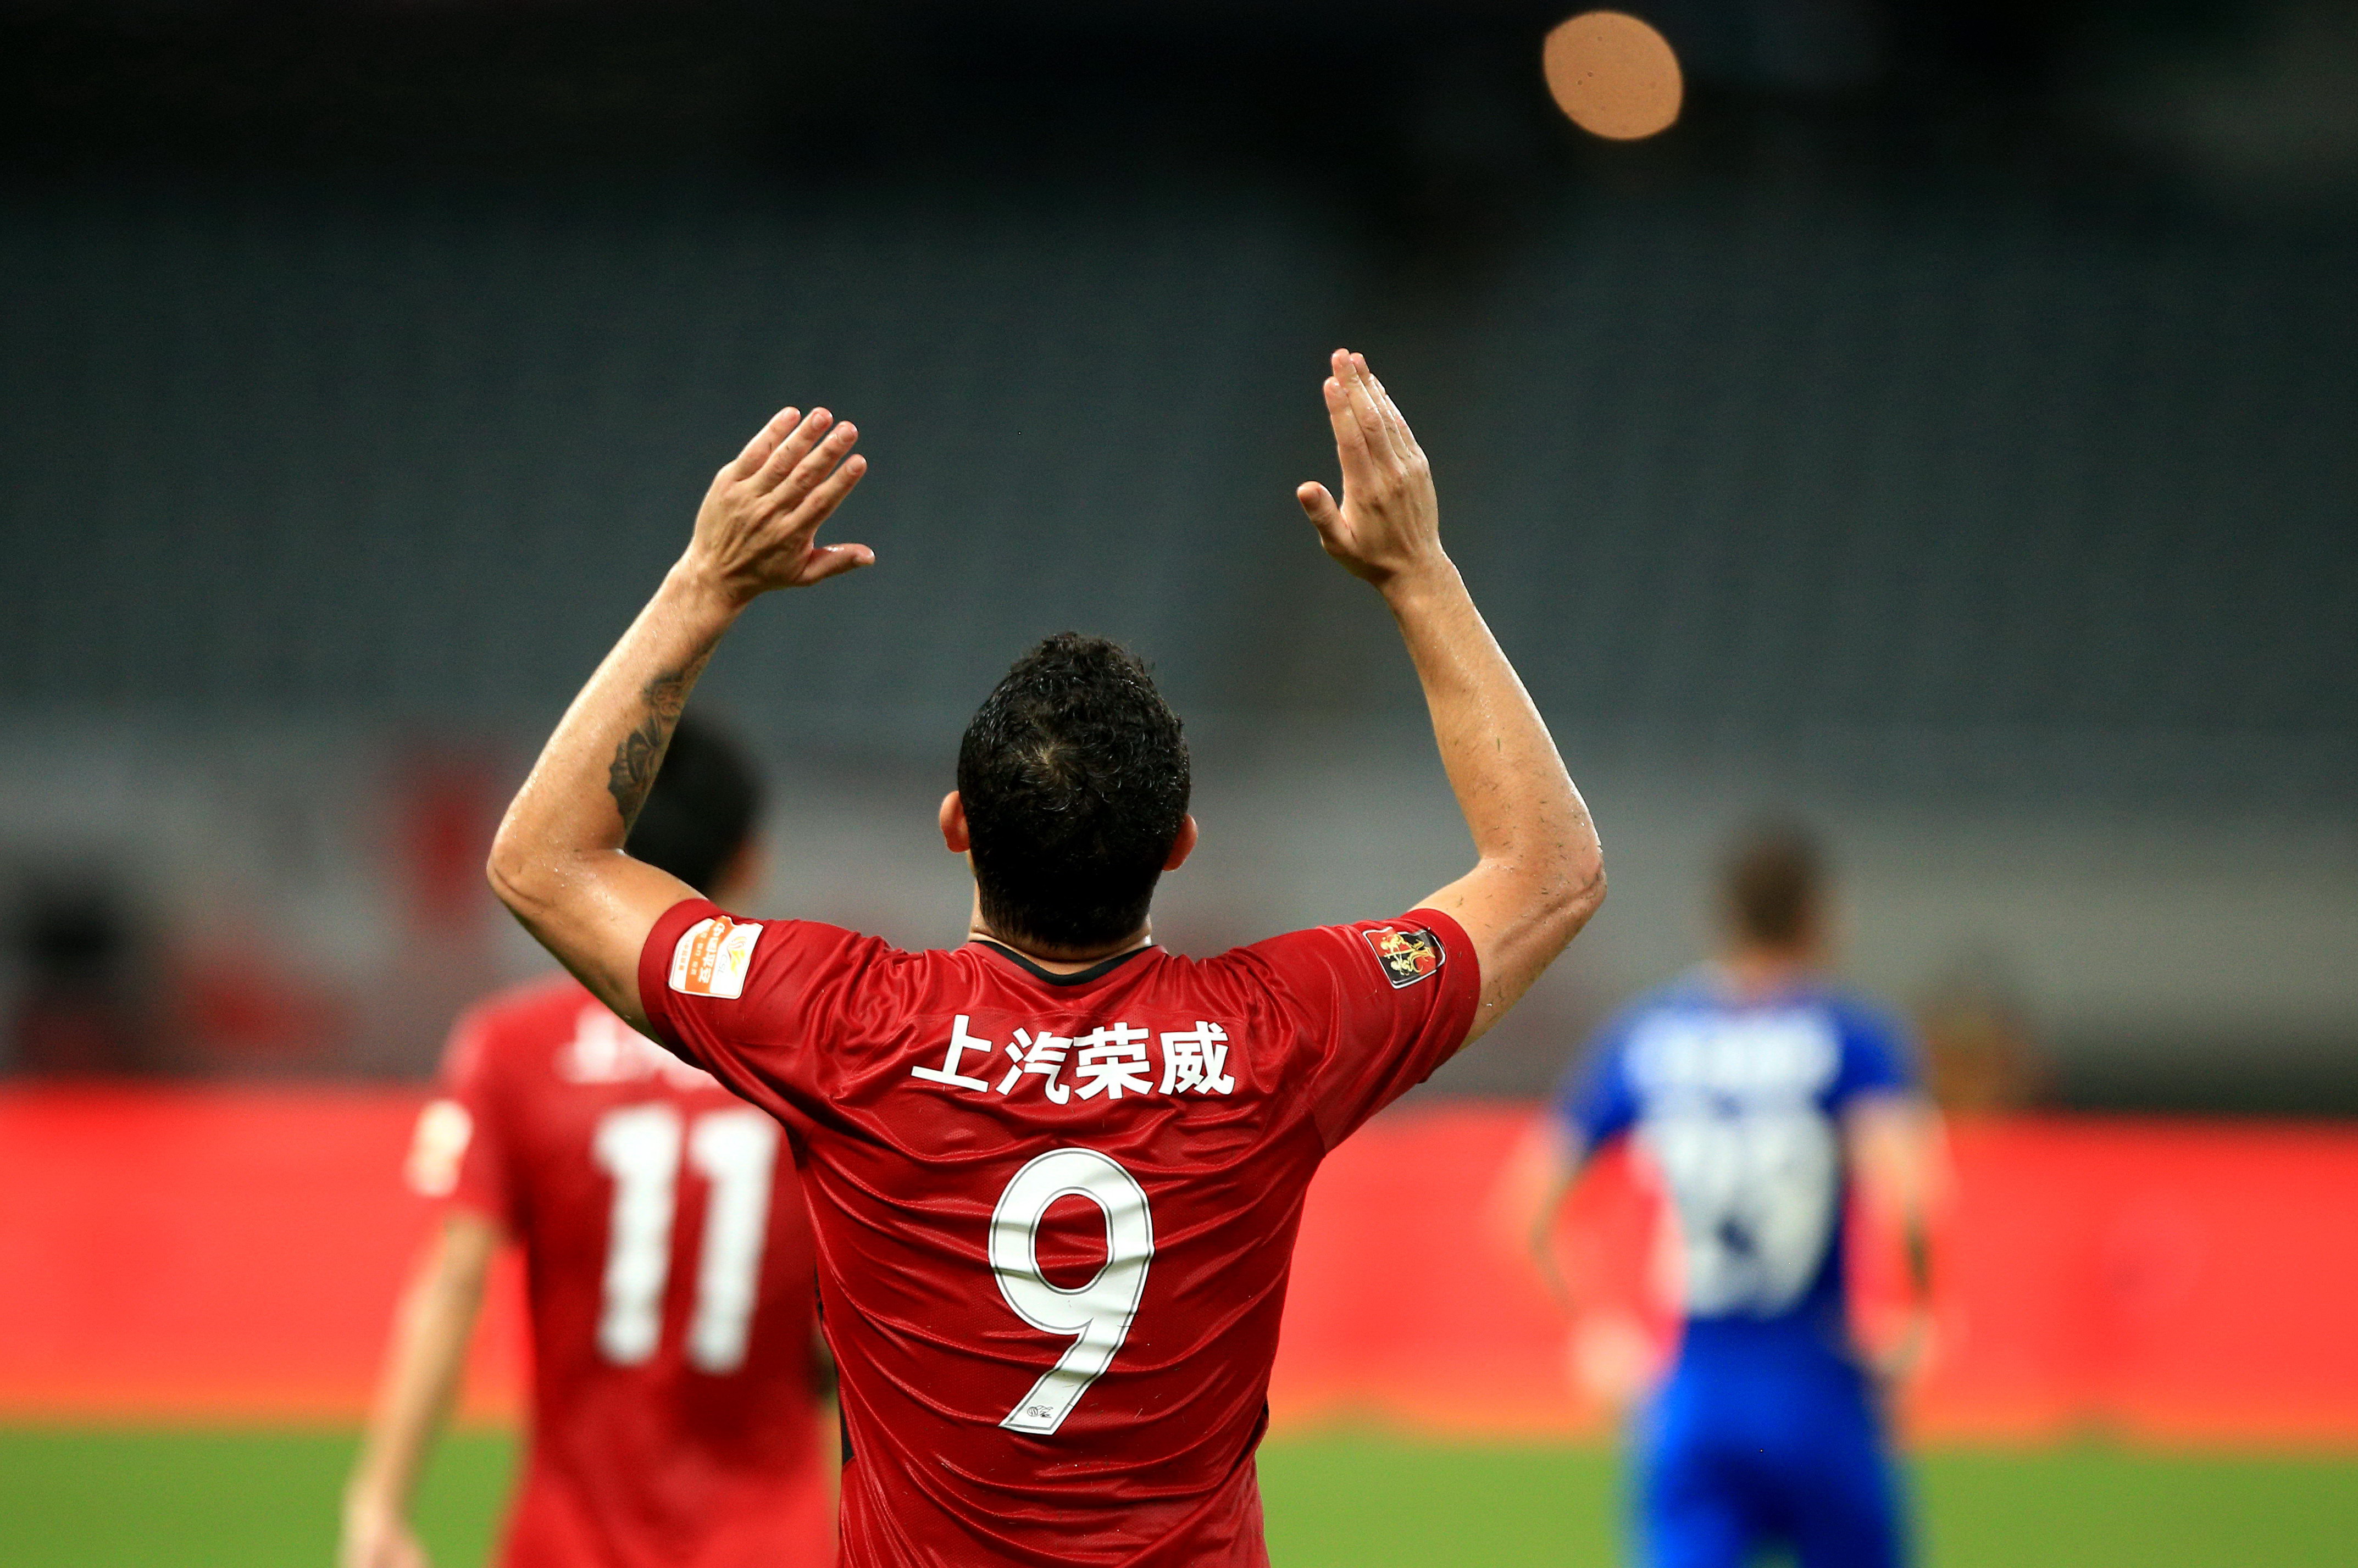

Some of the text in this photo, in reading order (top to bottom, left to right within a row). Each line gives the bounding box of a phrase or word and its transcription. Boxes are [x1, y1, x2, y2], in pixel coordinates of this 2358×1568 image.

[718, 954, 728, 975] CSL
[911, 1014, 1235, 1104] 上汽荣威
[595, 1104, 775, 1372] 11
[988, 1148, 1155, 1435] 9
